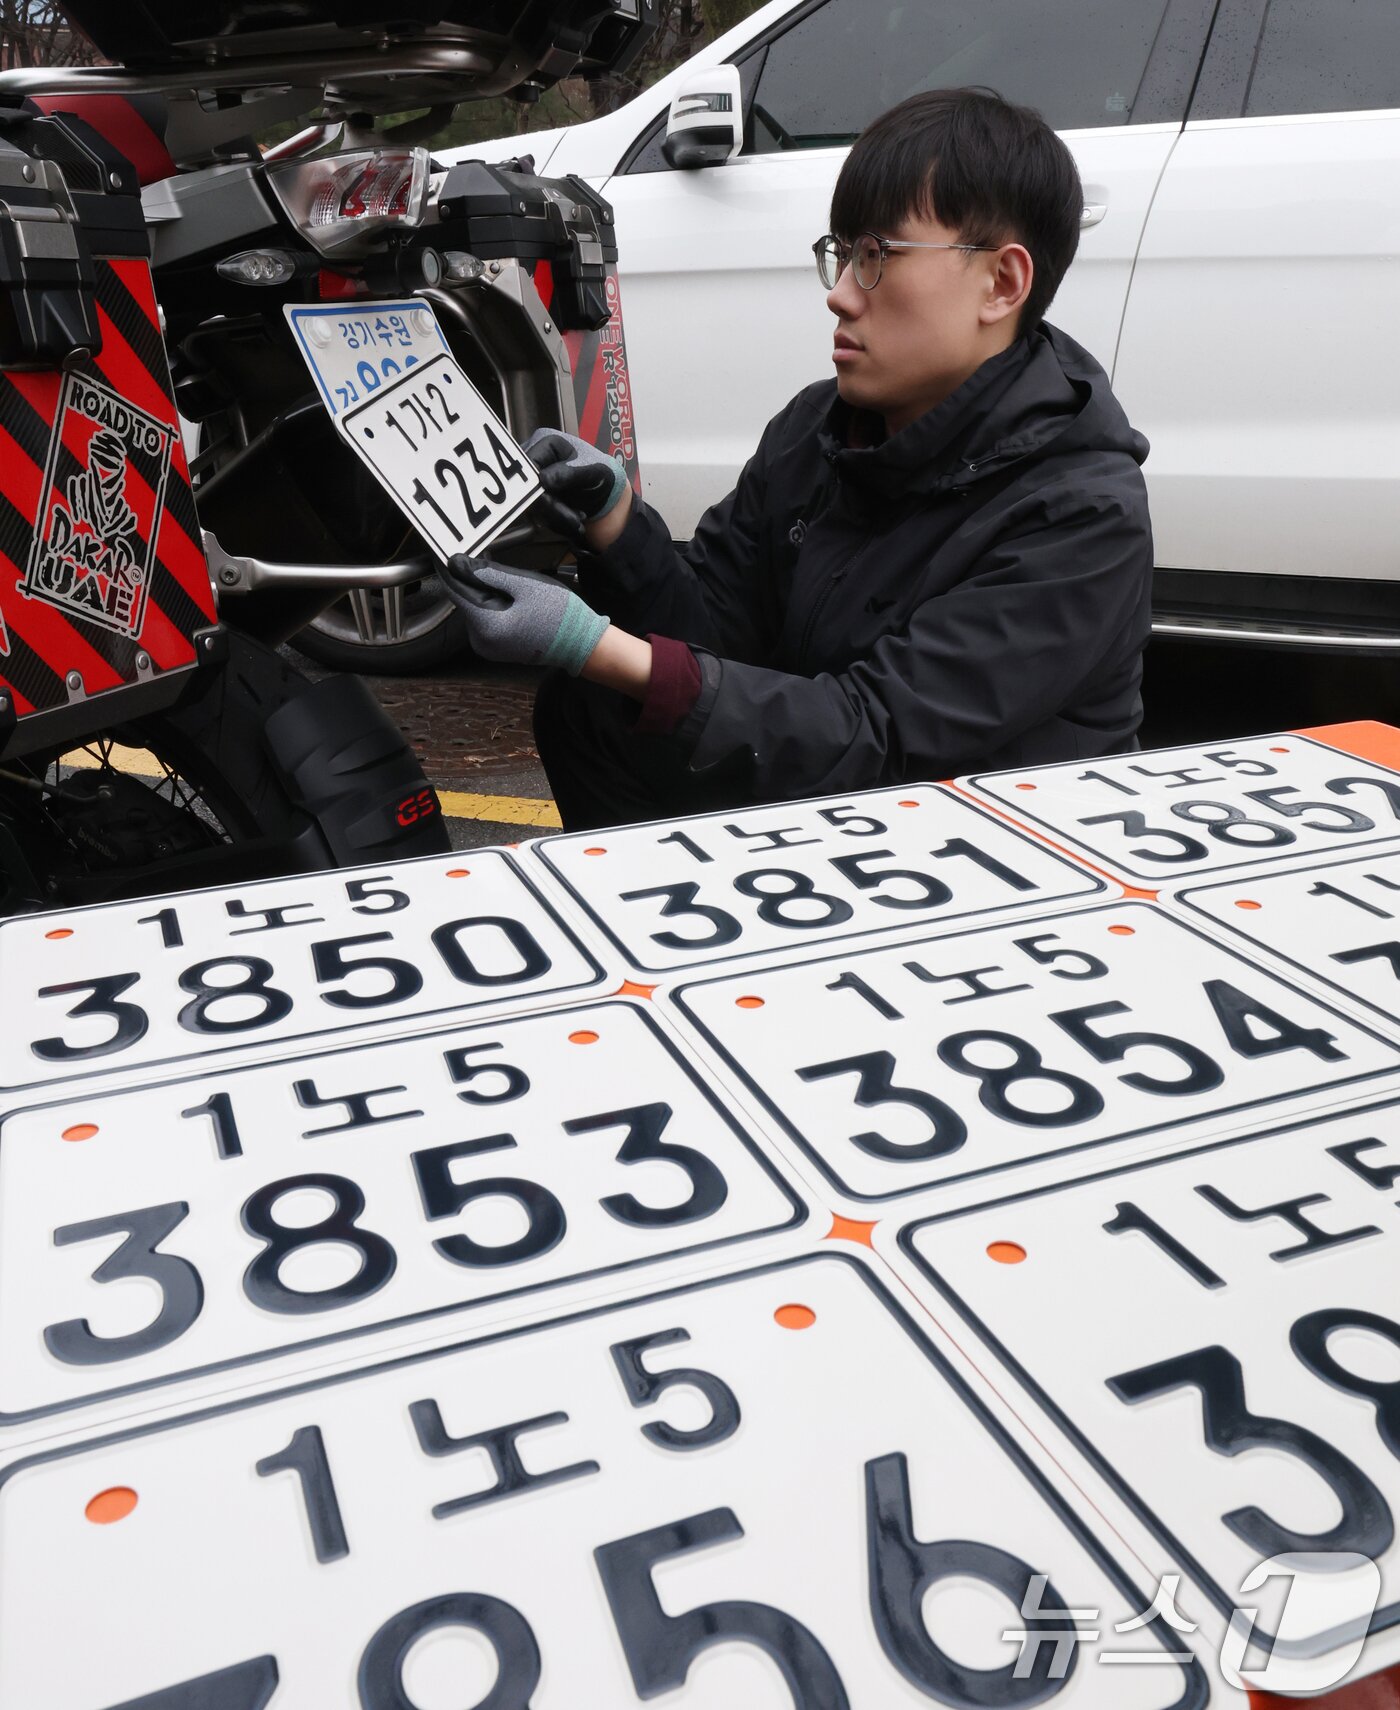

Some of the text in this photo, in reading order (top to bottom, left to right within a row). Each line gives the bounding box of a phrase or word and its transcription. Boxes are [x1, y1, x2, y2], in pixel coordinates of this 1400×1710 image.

[338, 315, 412, 349] 경기수원
[69, 380, 161, 456] ROAD TO
[385, 383, 460, 452] 1가2
[613, 347, 634, 460] WORLD
[412, 422, 529, 543] 1234
[39, 556, 133, 623] UAE
[49, 504, 135, 590] DAKAR
[396, 789, 435, 827] GS
[1077, 751, 1278, 796] 1노5
[657, 806, 888, 863] 1노5
[137, 876, 410, 949] 1노5
[618, 838, 1041, 951] 3851
[30, 916, 553, 1062] 3850
[824, 933, 1109, 1021] 1노5
[181, 1042, 531, 1161] 1노5
[794, 979, 1351, 1164] 3854
[43, 1102, 729, 1366] 3853
[255, 1327, 742, 1565] 1노5
